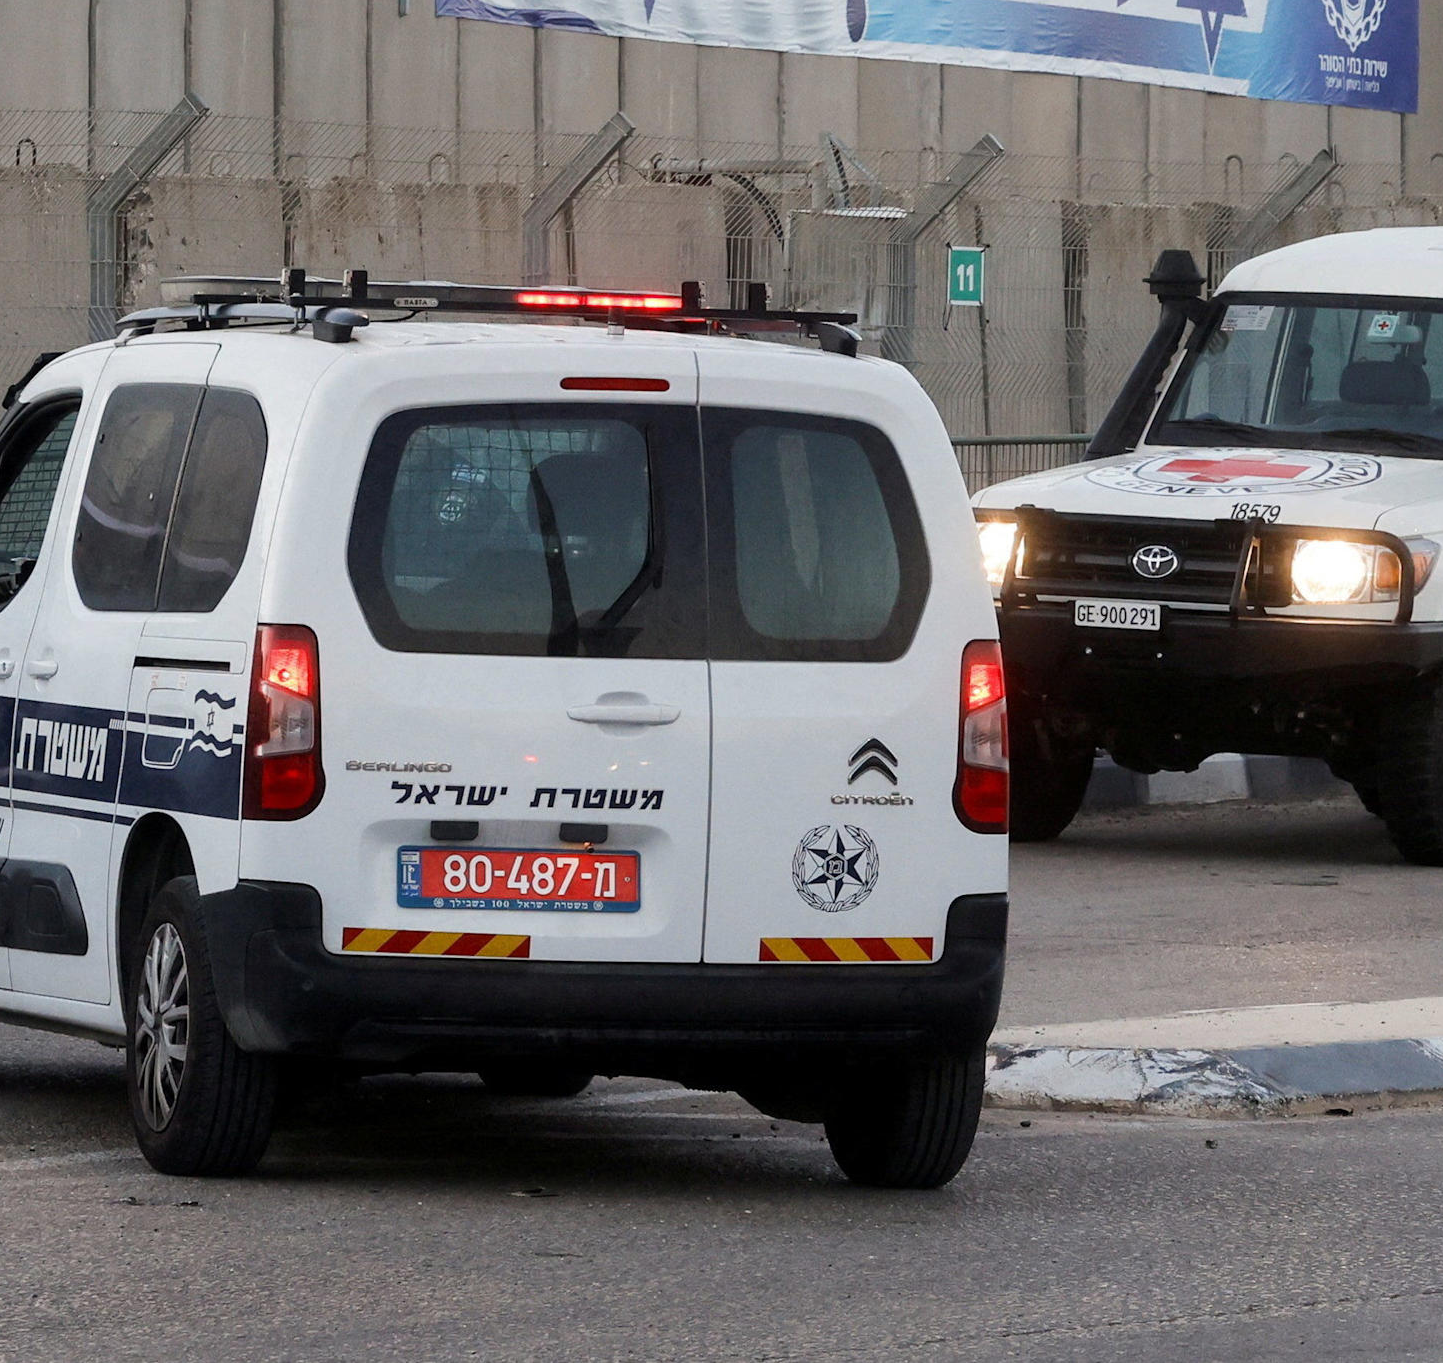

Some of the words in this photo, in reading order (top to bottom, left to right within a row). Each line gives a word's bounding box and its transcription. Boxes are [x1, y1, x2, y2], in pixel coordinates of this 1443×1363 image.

[1318, 54, 1345, 73] הסוהר
[1363, 59, 1388, 79] שירות
[956, 263, 975, 292] 11
[1230, 501, 1282, 524] 18579
[15, 717, 109, 783] משטרת
[345, 760, 453, 774] BERLINGO
[390, 781, 508, 807] ישראל
[529, 787, 664, 811] משטרת
[492, 899, 510, 908] 100
[517, 899, 547, 909] ישראל
[554, 902, 588, 910] משטרת
